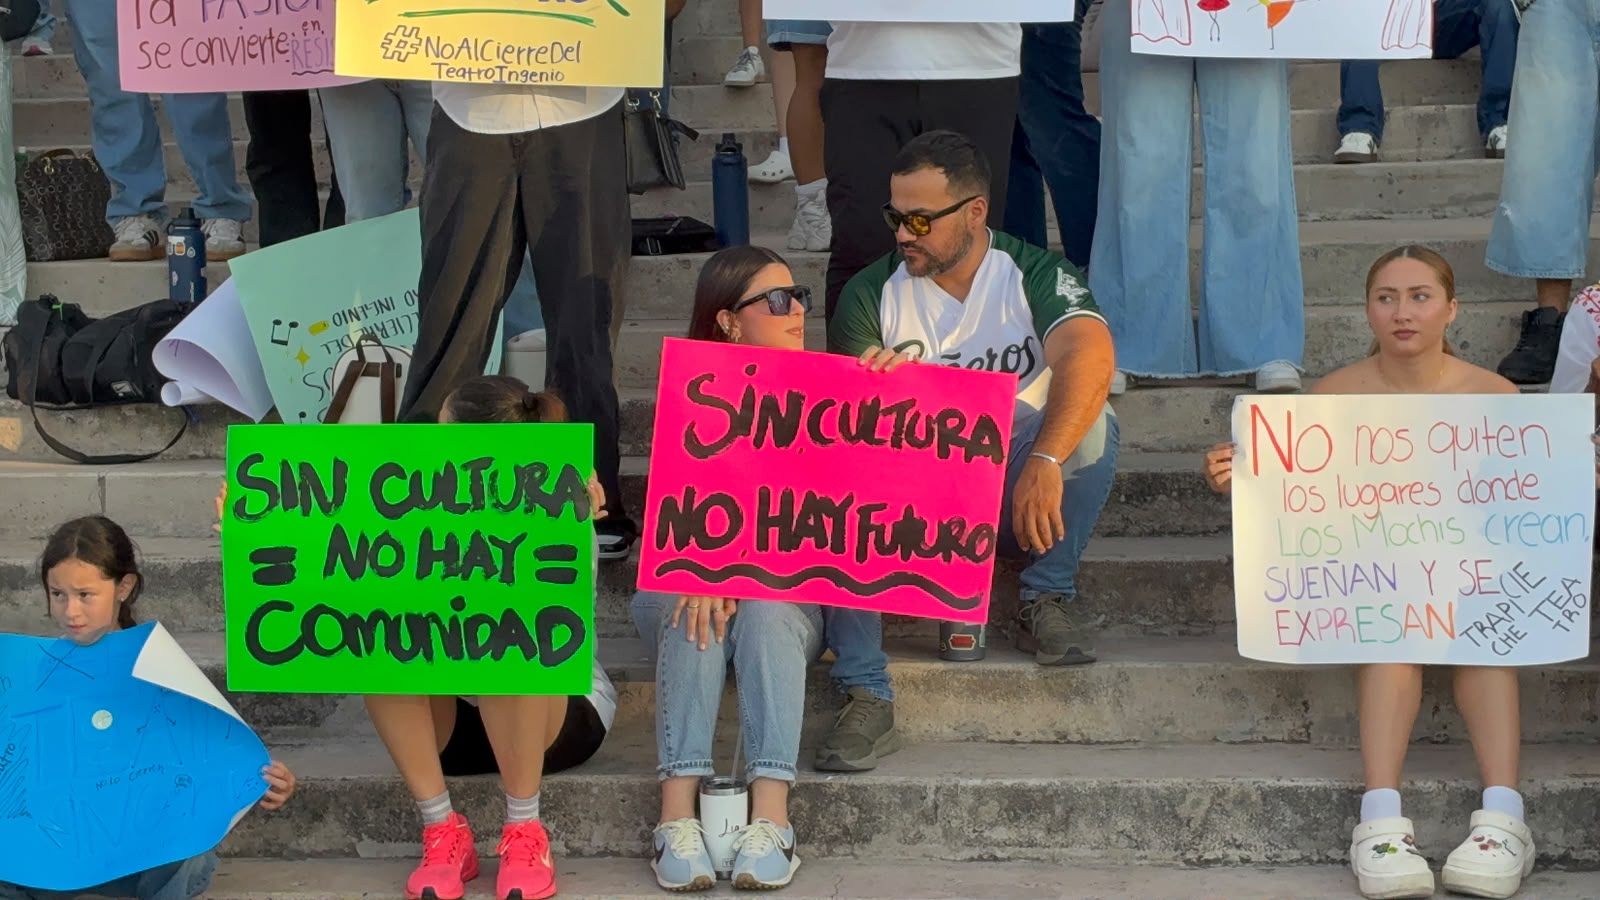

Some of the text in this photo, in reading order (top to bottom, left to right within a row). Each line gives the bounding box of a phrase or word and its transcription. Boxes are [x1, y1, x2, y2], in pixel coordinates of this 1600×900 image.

[137, 41, 172, 70] se
[291, 37, 335, 70] RESI
[806, 395, 1005, 464] CULTURA
[1355, 424, 1414, 466] nos
[1428, 416, 1551, 471] quiten
[233, 453, 592, 522] SIN CULTURA
[1282, 469, 1541, 519] los lugares donde
[656, 485, 744, 552] NO
[756, 486, 854, 555] HAY
[1352, 511, 1465, 549] Mochis
[322, 524, 406, 581] NO
[415, 526, 529, 586] HAY
[1264, 559, 1500, 603] SUEÑAN Y SE
[1275, 601, 1456, 646] EXPRESAN
